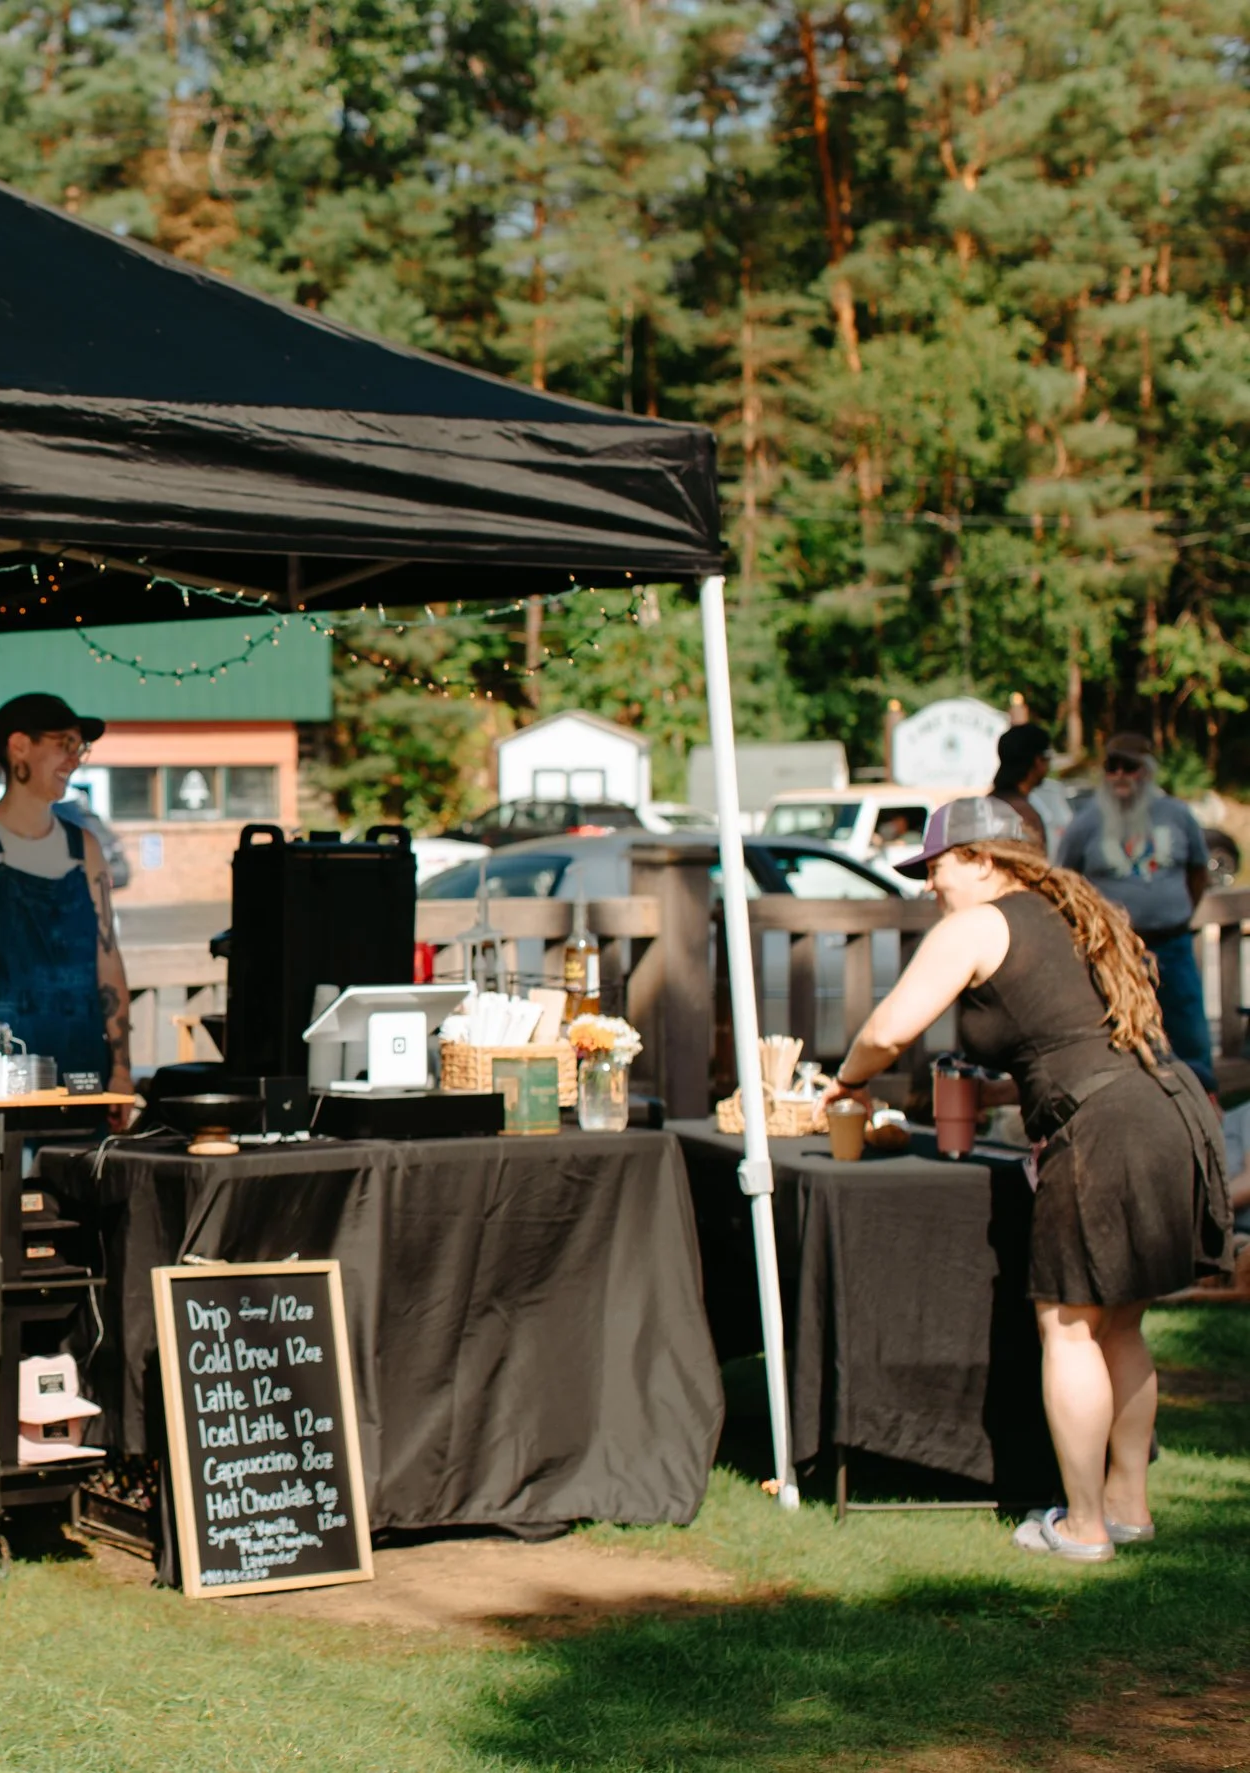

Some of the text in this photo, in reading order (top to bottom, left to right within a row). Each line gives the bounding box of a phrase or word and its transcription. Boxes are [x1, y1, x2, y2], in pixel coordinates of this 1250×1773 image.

[186, 1299, 232, 1343] Drip
[188, 1336, 323, 1375] Cold Brew 12oz
[194, 1376, 293, 1414] Latte 12oz
[197, 1407, 334, 1449] Iced Latte 12oz
[203, 1440, 335, 1490] Cappuccino 8oz
[205, 1490, 240, 1521] Hot
[240, 1477, 315, 1515] Chocolate
